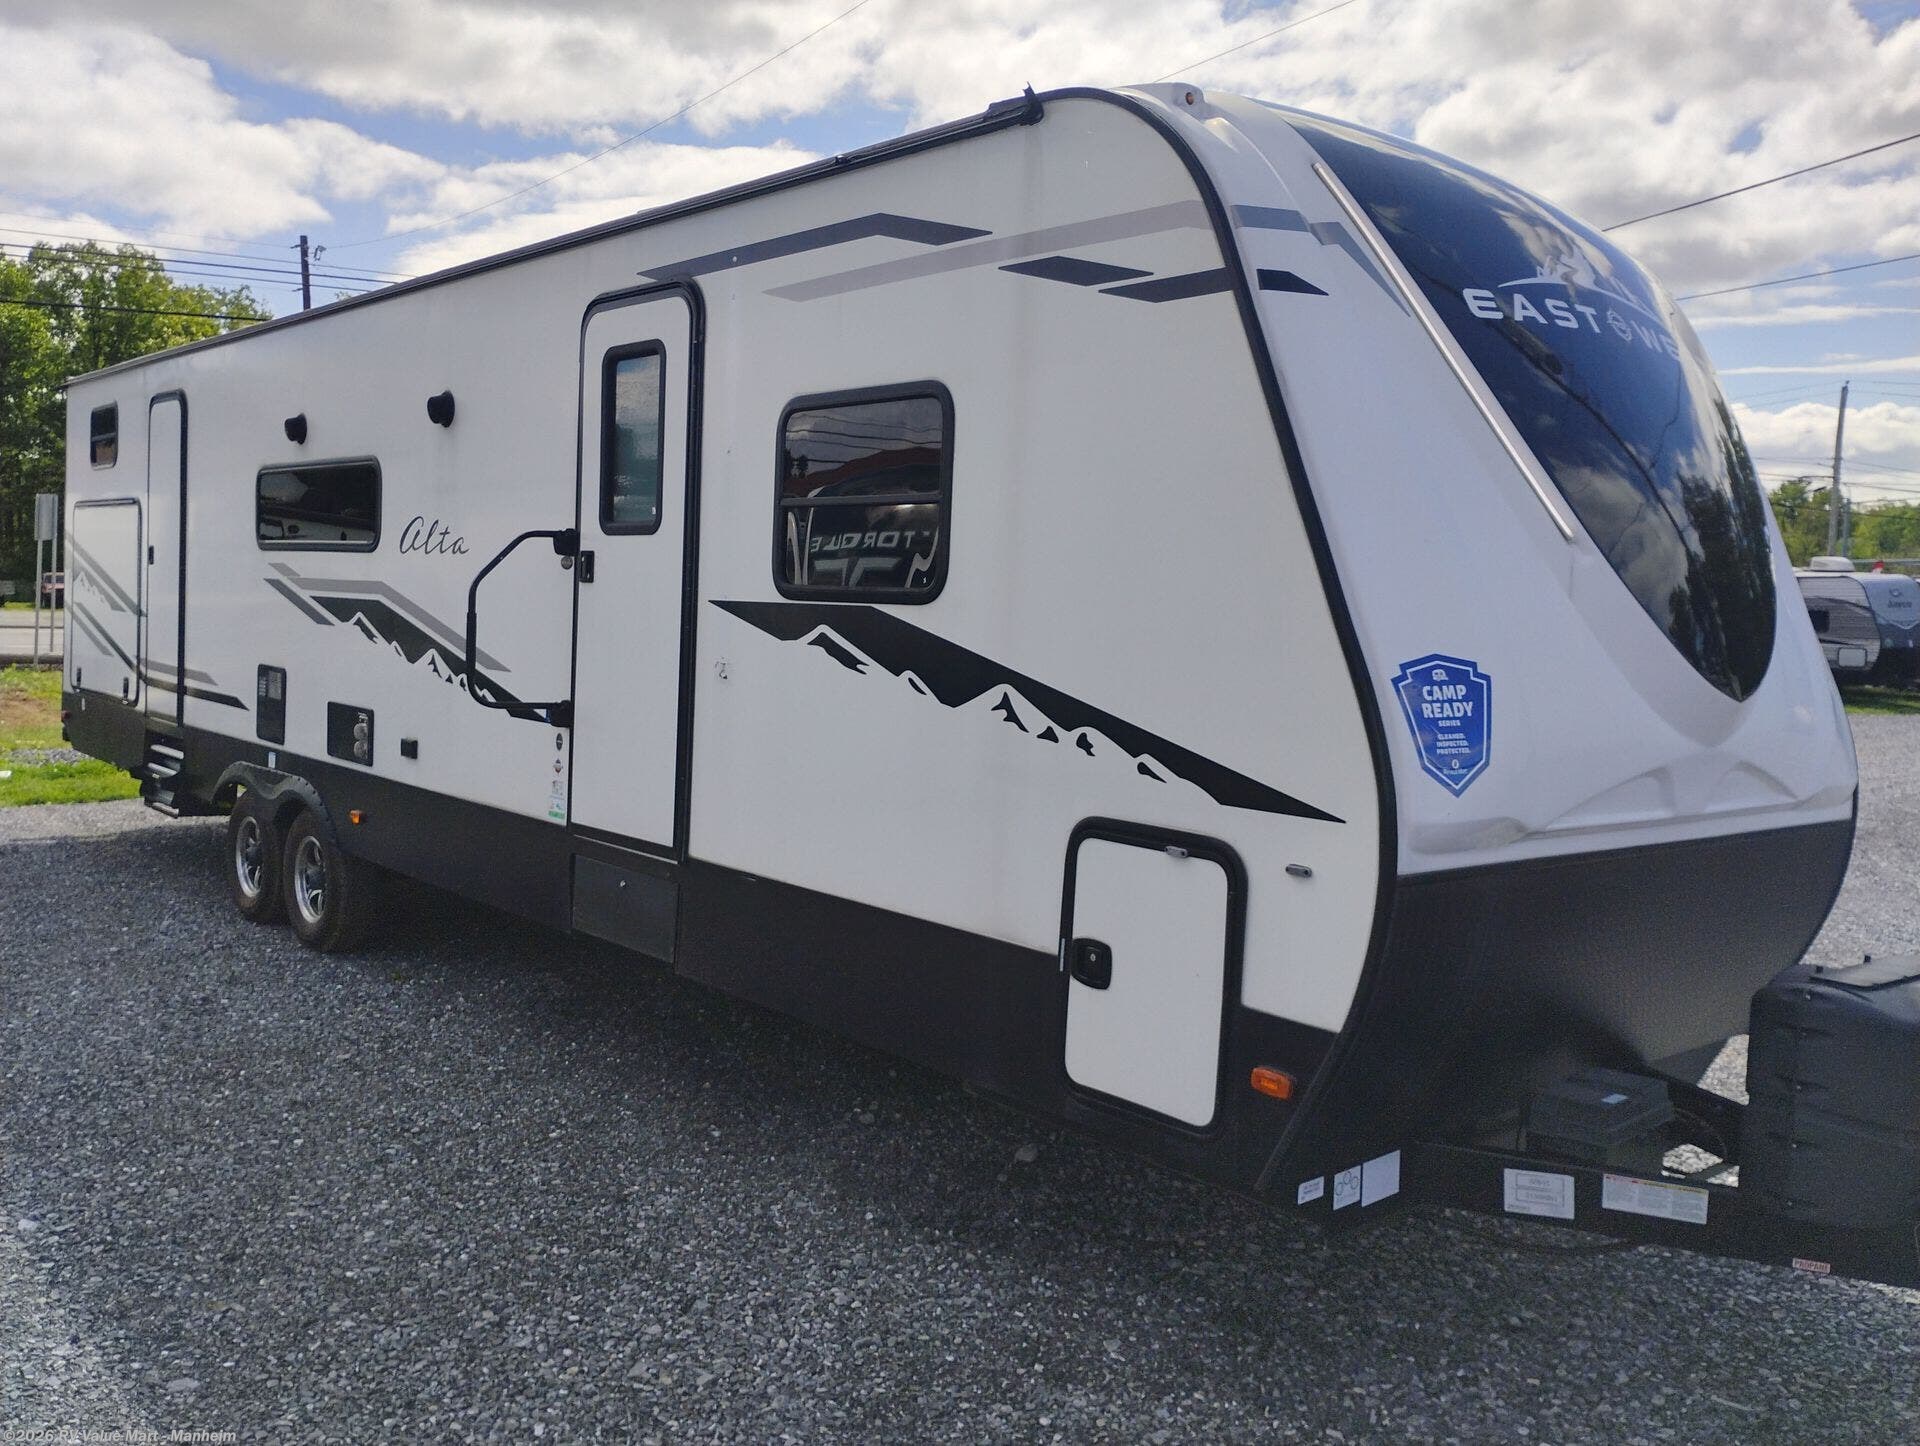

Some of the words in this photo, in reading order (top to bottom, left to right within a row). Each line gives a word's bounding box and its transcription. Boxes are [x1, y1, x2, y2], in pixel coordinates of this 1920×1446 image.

[1462, 288, 1602, 334] EAST
[399, 515, 470, 555] Alta
[1422, 684, 1467, 701] CAMP
[1421, 701, 1474, 719] READY
[1438, 719, 1461, 727] SERIES
